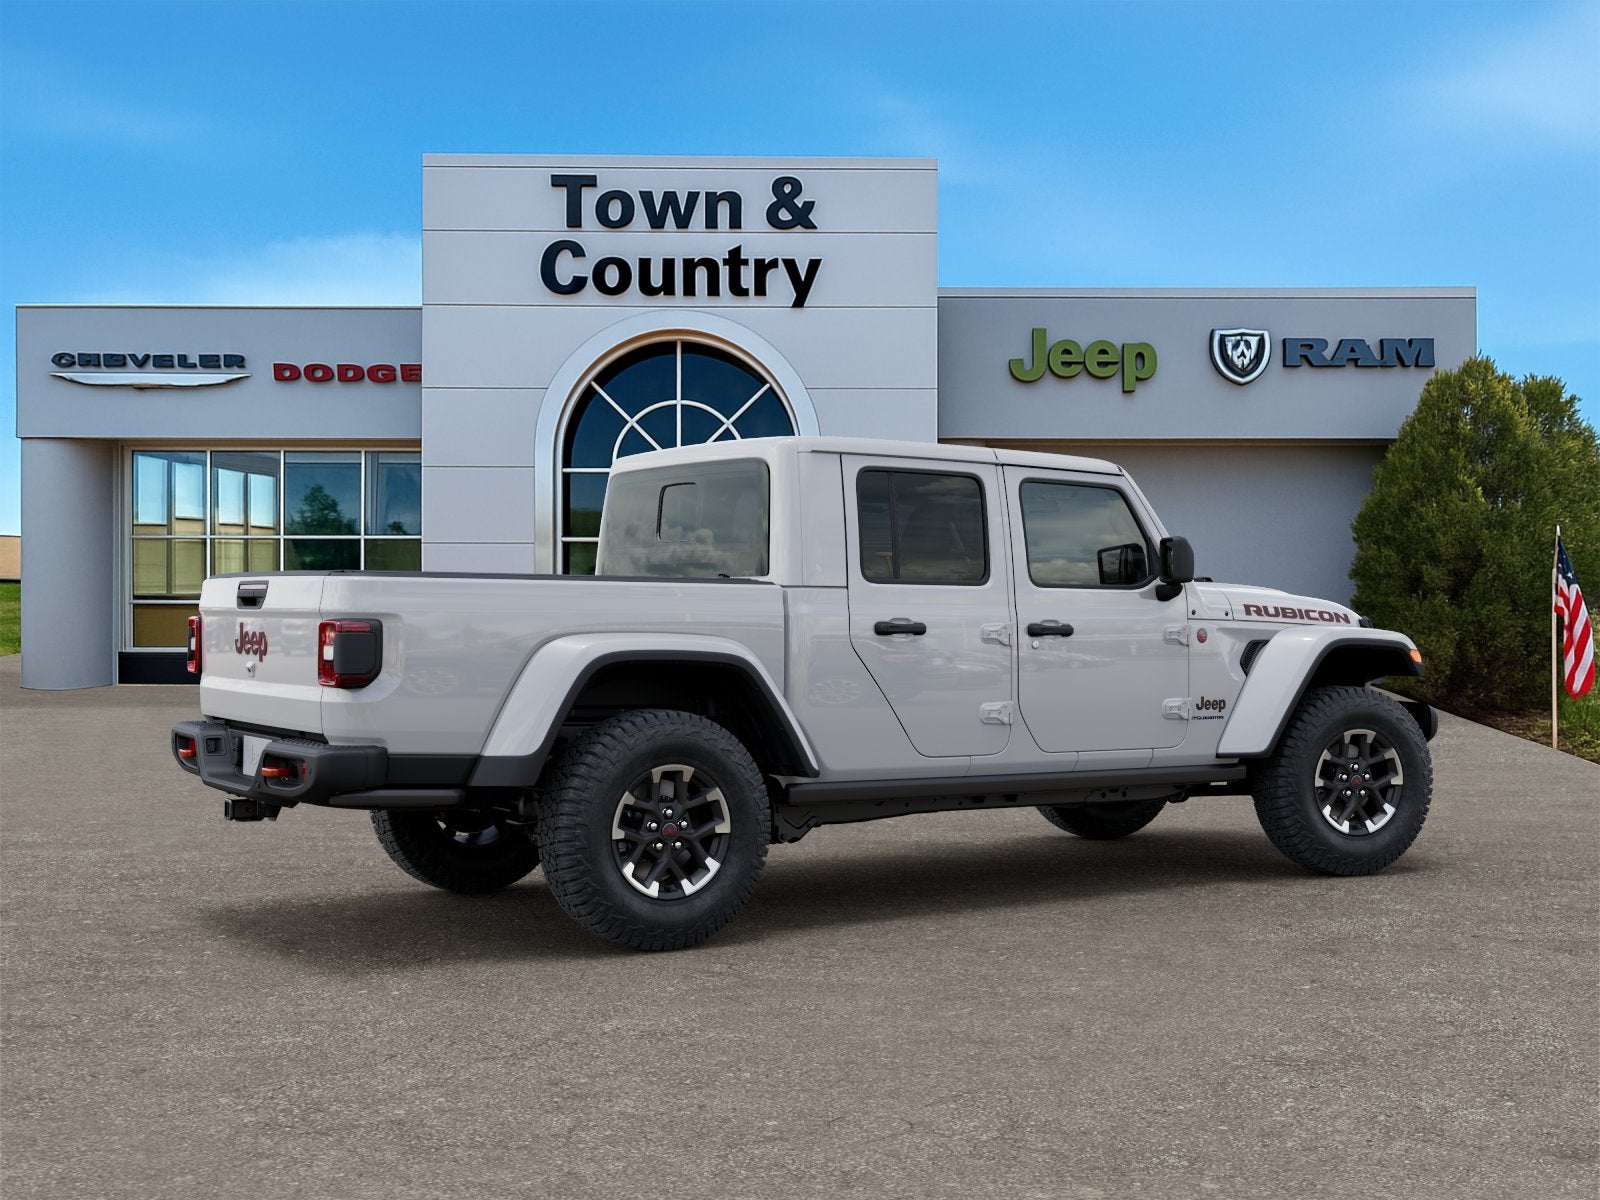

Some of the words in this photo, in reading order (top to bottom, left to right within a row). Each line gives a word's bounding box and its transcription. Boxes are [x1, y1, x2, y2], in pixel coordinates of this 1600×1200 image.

[550, 174, 742, 229] Town
[765, 175, 818, 230] &
[539, 239, 823, 308] Country
[1008, 328, 1158, 393] Jeep
[1282, 337, 1436, 368] RAM
[273, 363, 422, 383] DODGE
[1243, 603, 1351, 625] RUBICON
[235, 622, 268, 663] Jeep
[1195, 695, 1227, 713] Jeep
